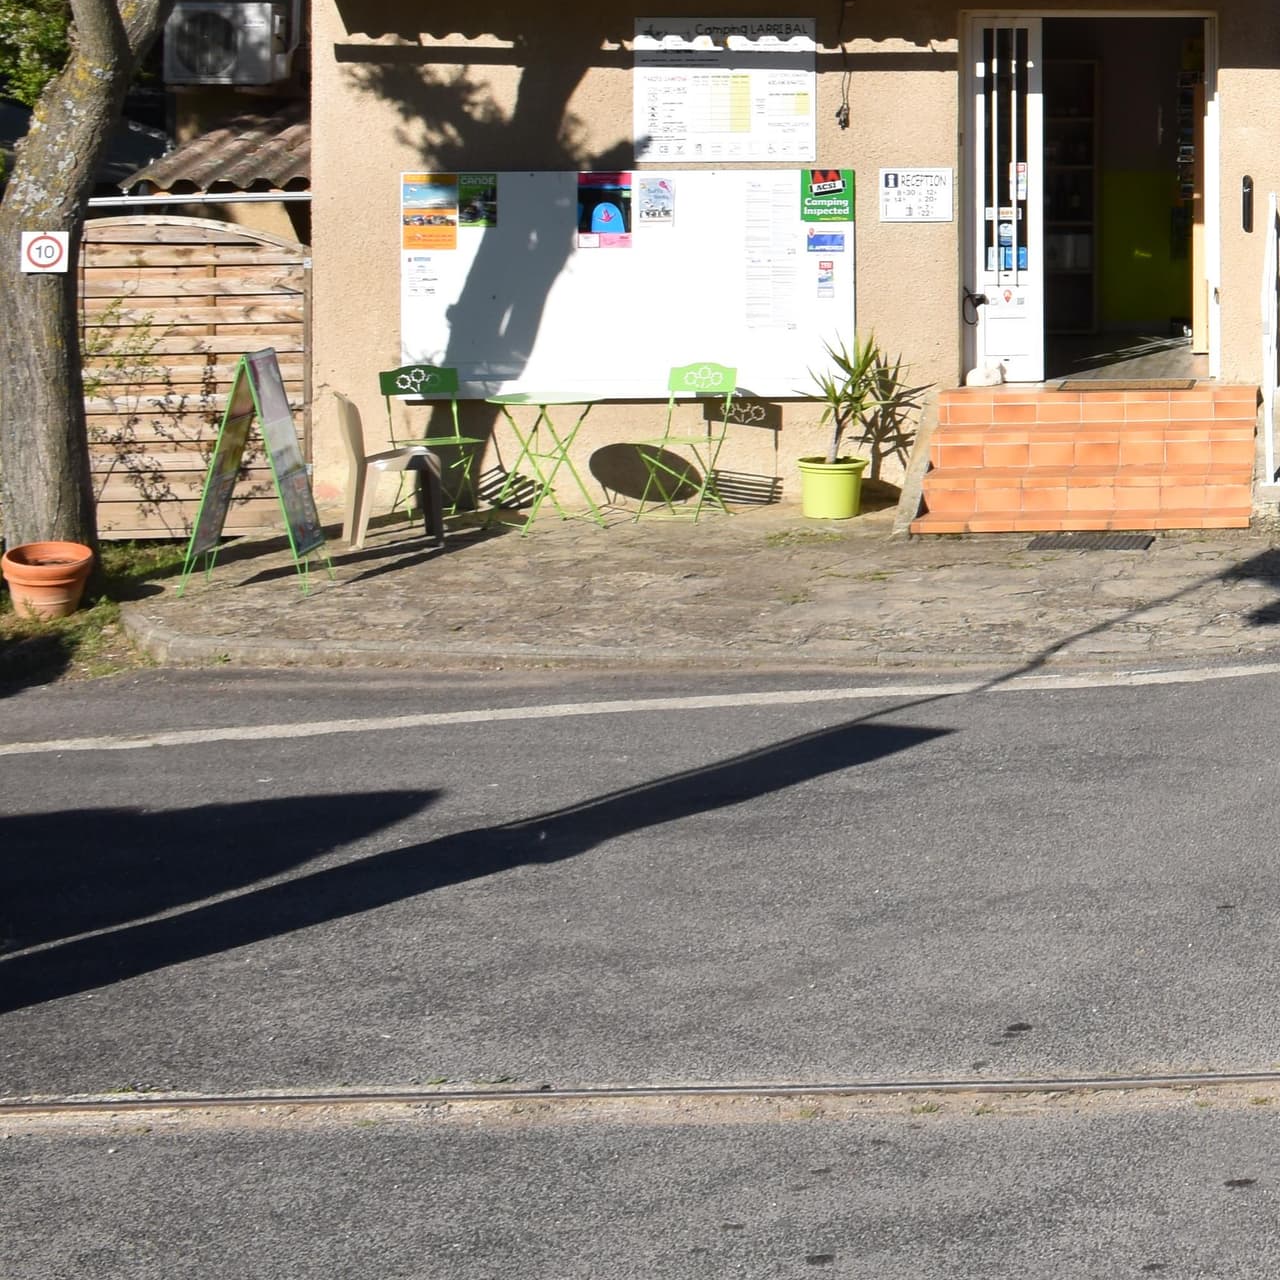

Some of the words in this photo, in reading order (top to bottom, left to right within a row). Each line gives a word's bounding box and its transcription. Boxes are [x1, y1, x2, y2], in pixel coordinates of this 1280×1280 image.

[695, 24, 747, 35] Camping
[751, 24, 808, 34] LARRIBAL
[901, 175, 946, 187] RECEPTION
[816, 183, 837, 191] ACSI
[804, 198, 849, 207] Camping
[804, 207, 850, 216] Inspected
[36, 245, 54, 258] 10
